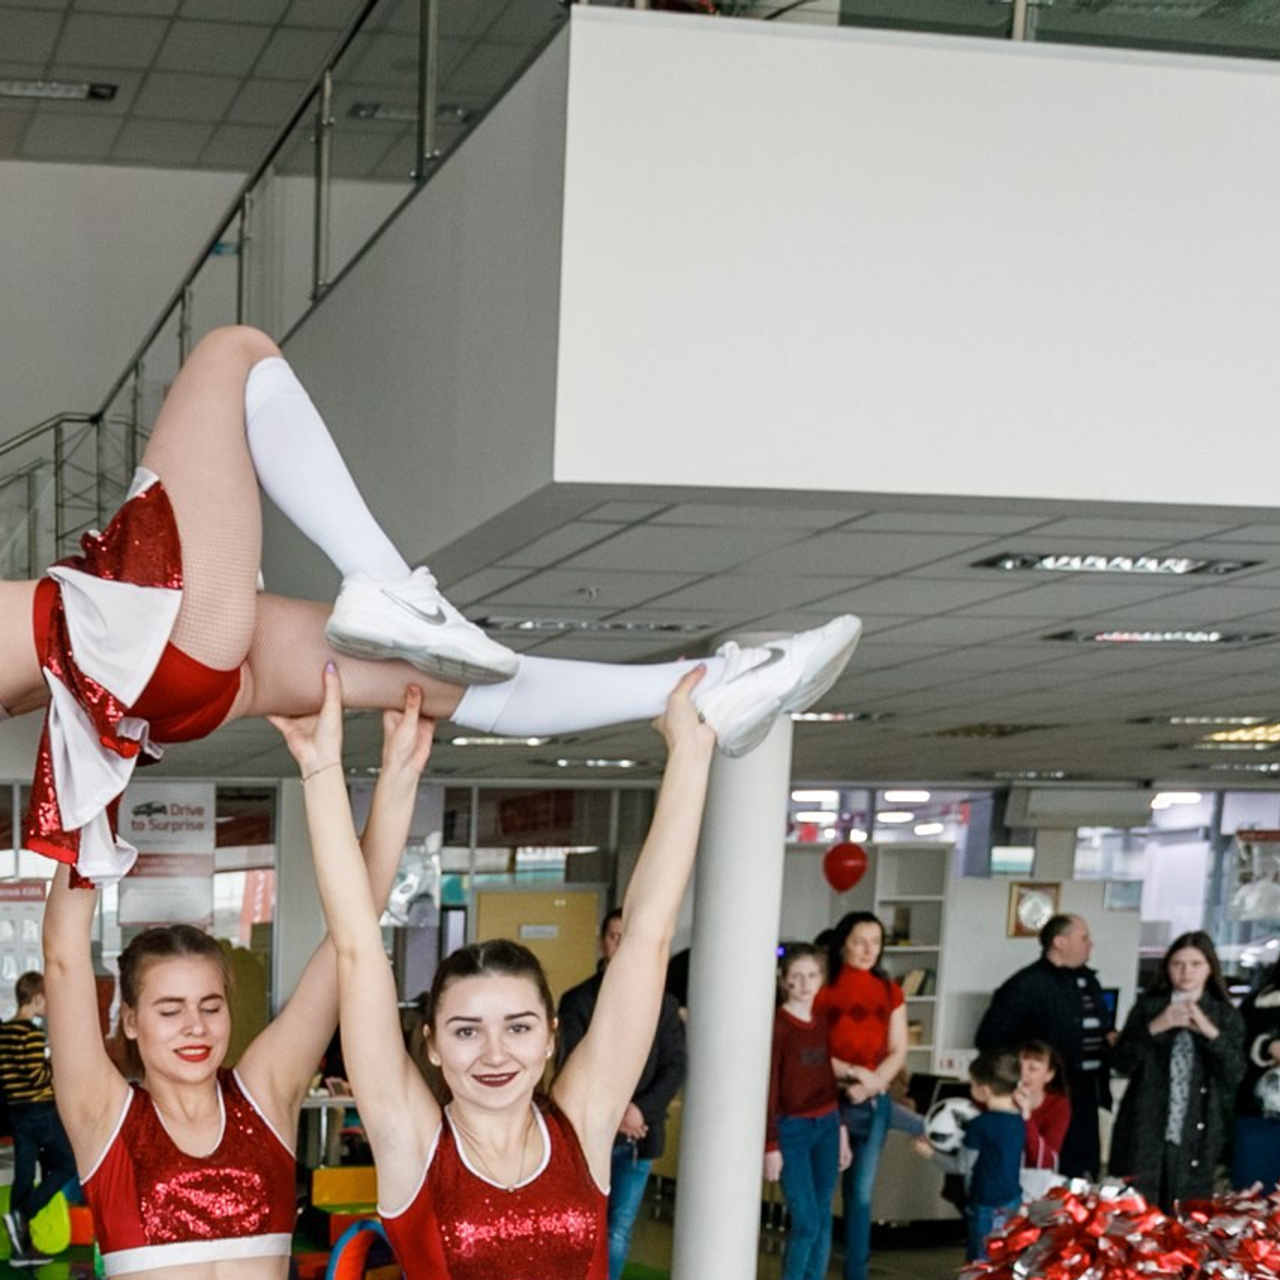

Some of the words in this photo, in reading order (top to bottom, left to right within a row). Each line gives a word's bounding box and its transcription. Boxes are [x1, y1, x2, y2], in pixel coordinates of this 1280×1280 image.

[169, 803, 205, 817] Drive
[131, 819, 146, 831] to
[148, 818, 205, 833] Surprise
